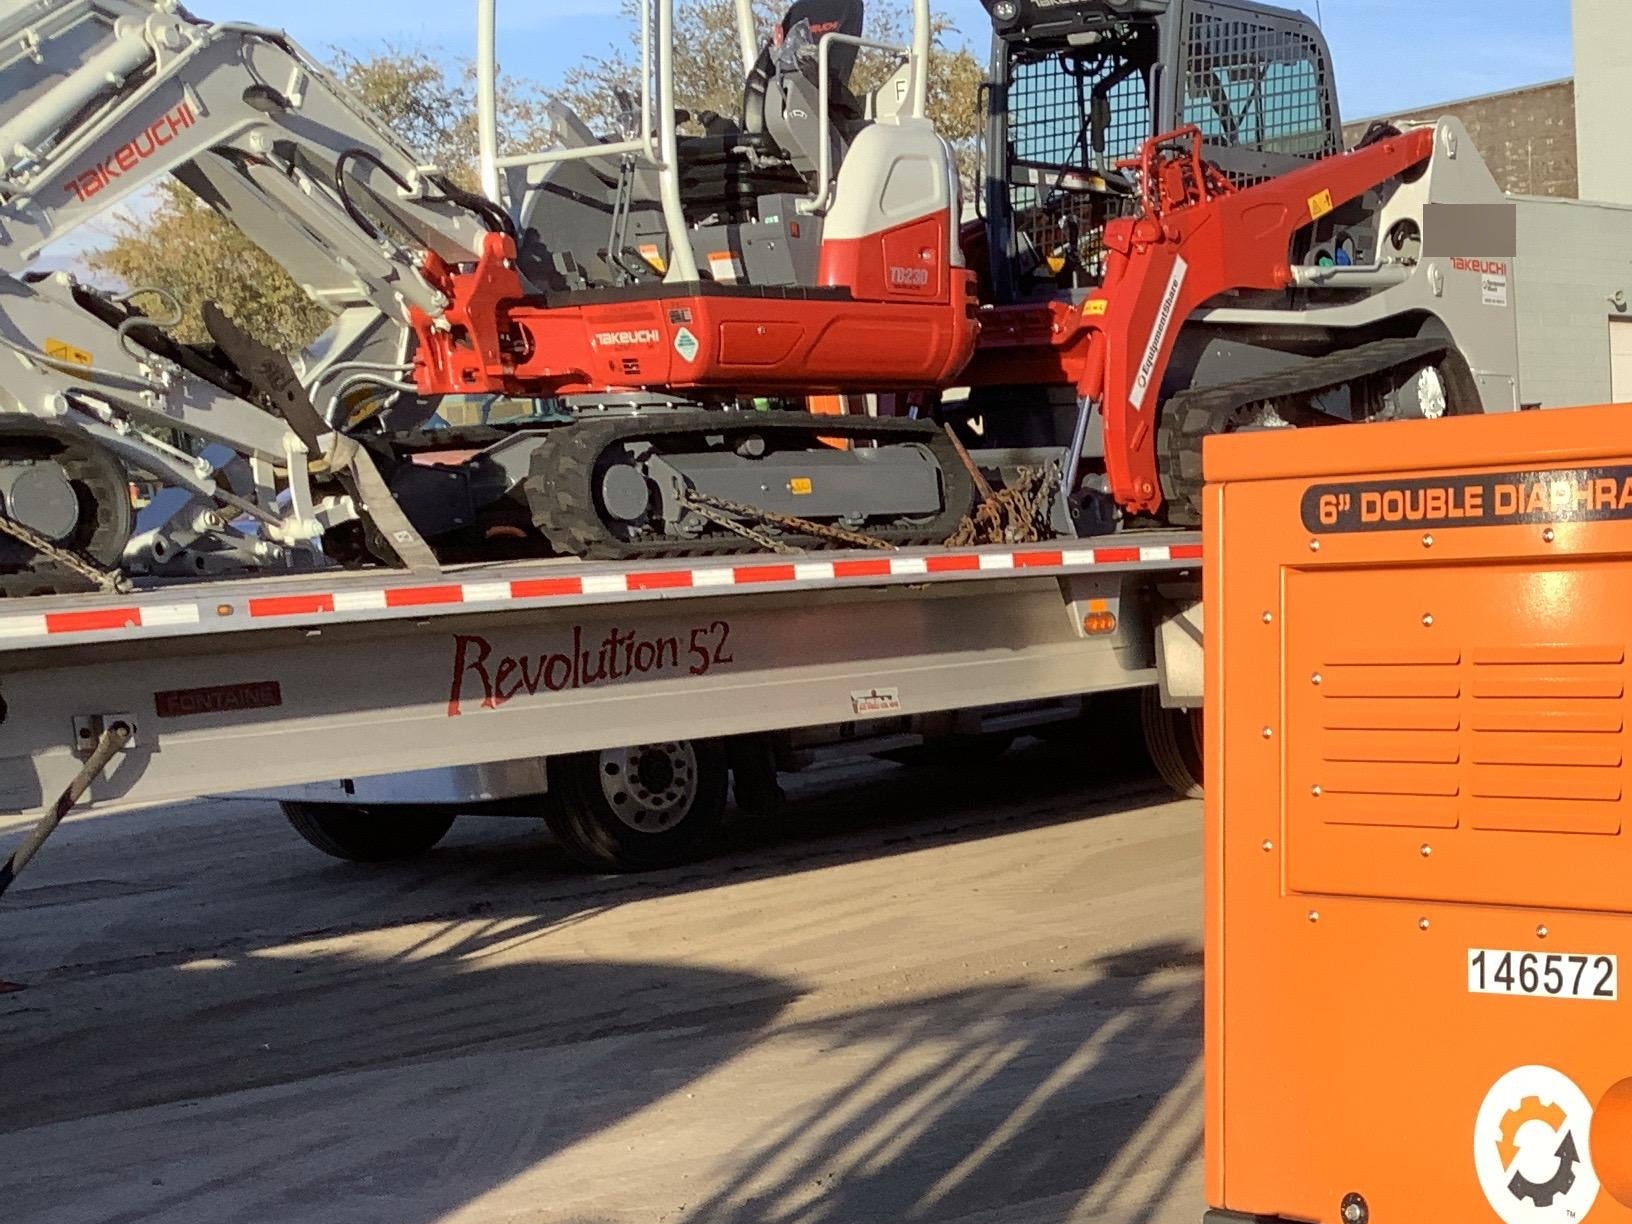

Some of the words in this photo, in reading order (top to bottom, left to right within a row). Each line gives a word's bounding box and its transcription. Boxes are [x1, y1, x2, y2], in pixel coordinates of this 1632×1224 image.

[64, 102, 197, 202] TAKEUCHI
[1449, 256, 1507, 276] TAKEUCHI
[595, 329, 660, 346] TAKEUCHI
[1143, 279, 1179, 376] EquipmentShare
[1360, 485, 1484, 523] DOUBLE
[447, 625, 679, 718] Revolution
[688, 620, 734, 676] 52
[1472, 950, 1615, 997] 146572
